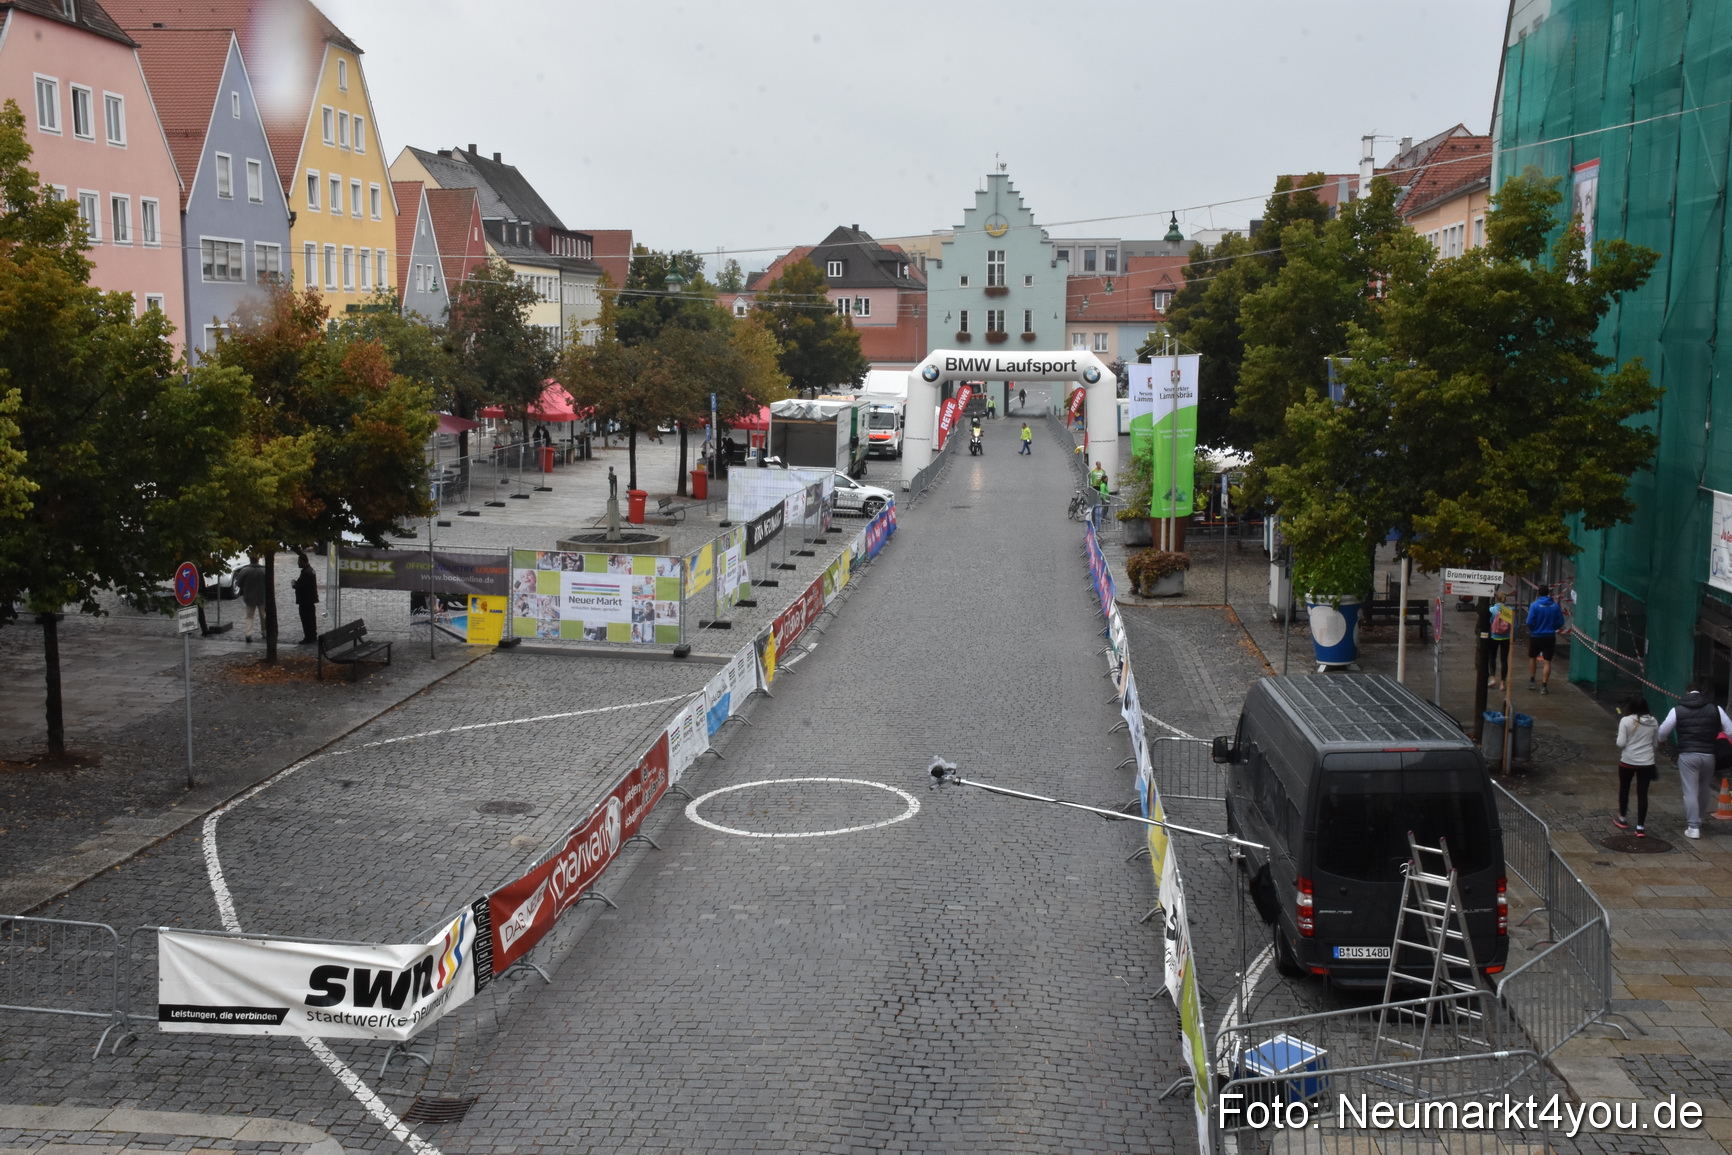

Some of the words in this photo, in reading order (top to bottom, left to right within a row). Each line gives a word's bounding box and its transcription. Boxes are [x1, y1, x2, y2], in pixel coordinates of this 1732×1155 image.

[945, 357, 991, 372] BMW
[995, 359, 1077, 375] Laufsport
[1071, 390, 1084, 413] REWE
[940, 401, 956, 431] REWE
[338, 559, 393, 573] BOCK
[1446, 570, 1503, 582] Brunnwirtsgasse
[568, 595, 596, 605] Neuer
[596, 597, 623, 606] Markt
[505, 912, 527, 943] DAS
[1339, 947, 1346, 957] B
[1351, 948, 1364, 957] US
[1365, 948, 1389, 958] 1480
[171, 1010, 218, 1020] Leistungen,
[219, 1011, 233, 1020] die
[235, 1012, 278, 1021] verbinden
[306, 1009, 408, 1028] stadtwerke
